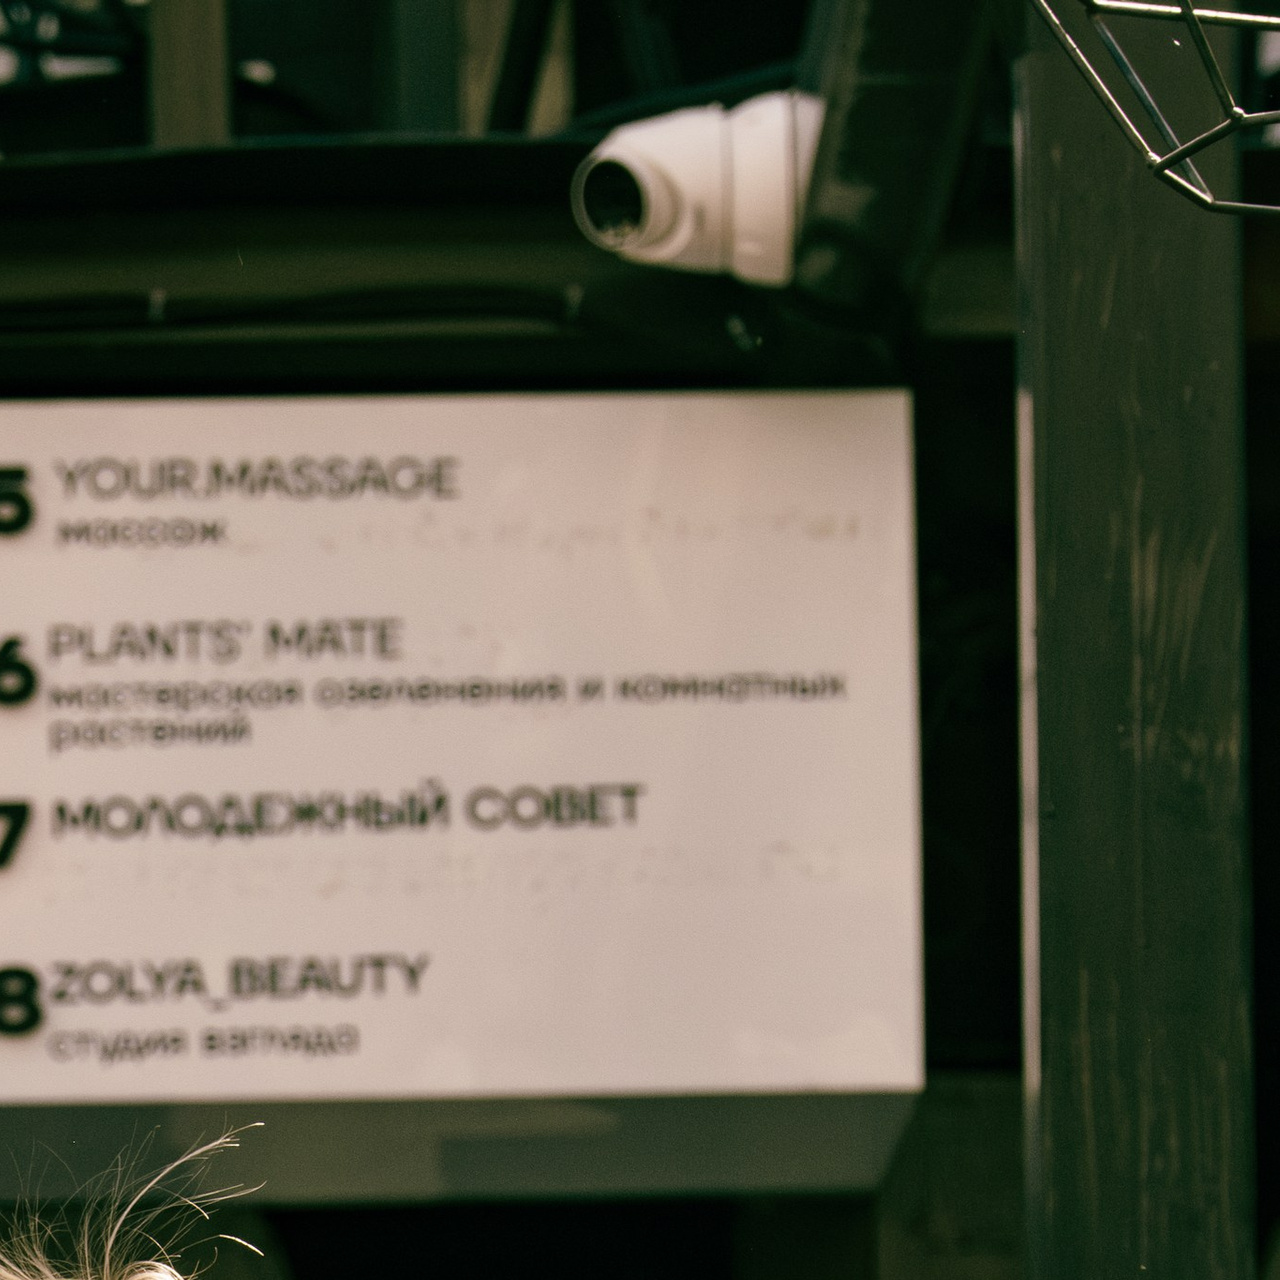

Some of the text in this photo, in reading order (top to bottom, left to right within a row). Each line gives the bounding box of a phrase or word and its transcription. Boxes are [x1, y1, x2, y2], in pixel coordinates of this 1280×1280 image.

[57, 457, 456, 499] YOUR.MASSAGE
[56, 518, 226, 547] массаж
[266, 618, 397, 660] MATE
[576, 678, 604, 702] и
[52, 779, 450, 839] МОЛОДЕЖНЫЙ
[465, 783, 643, 830] СОВЕТ
[48, 954, 428, 1010] ZOLYA_BEAUTY
[49, 1024, 188, 1061] студия
